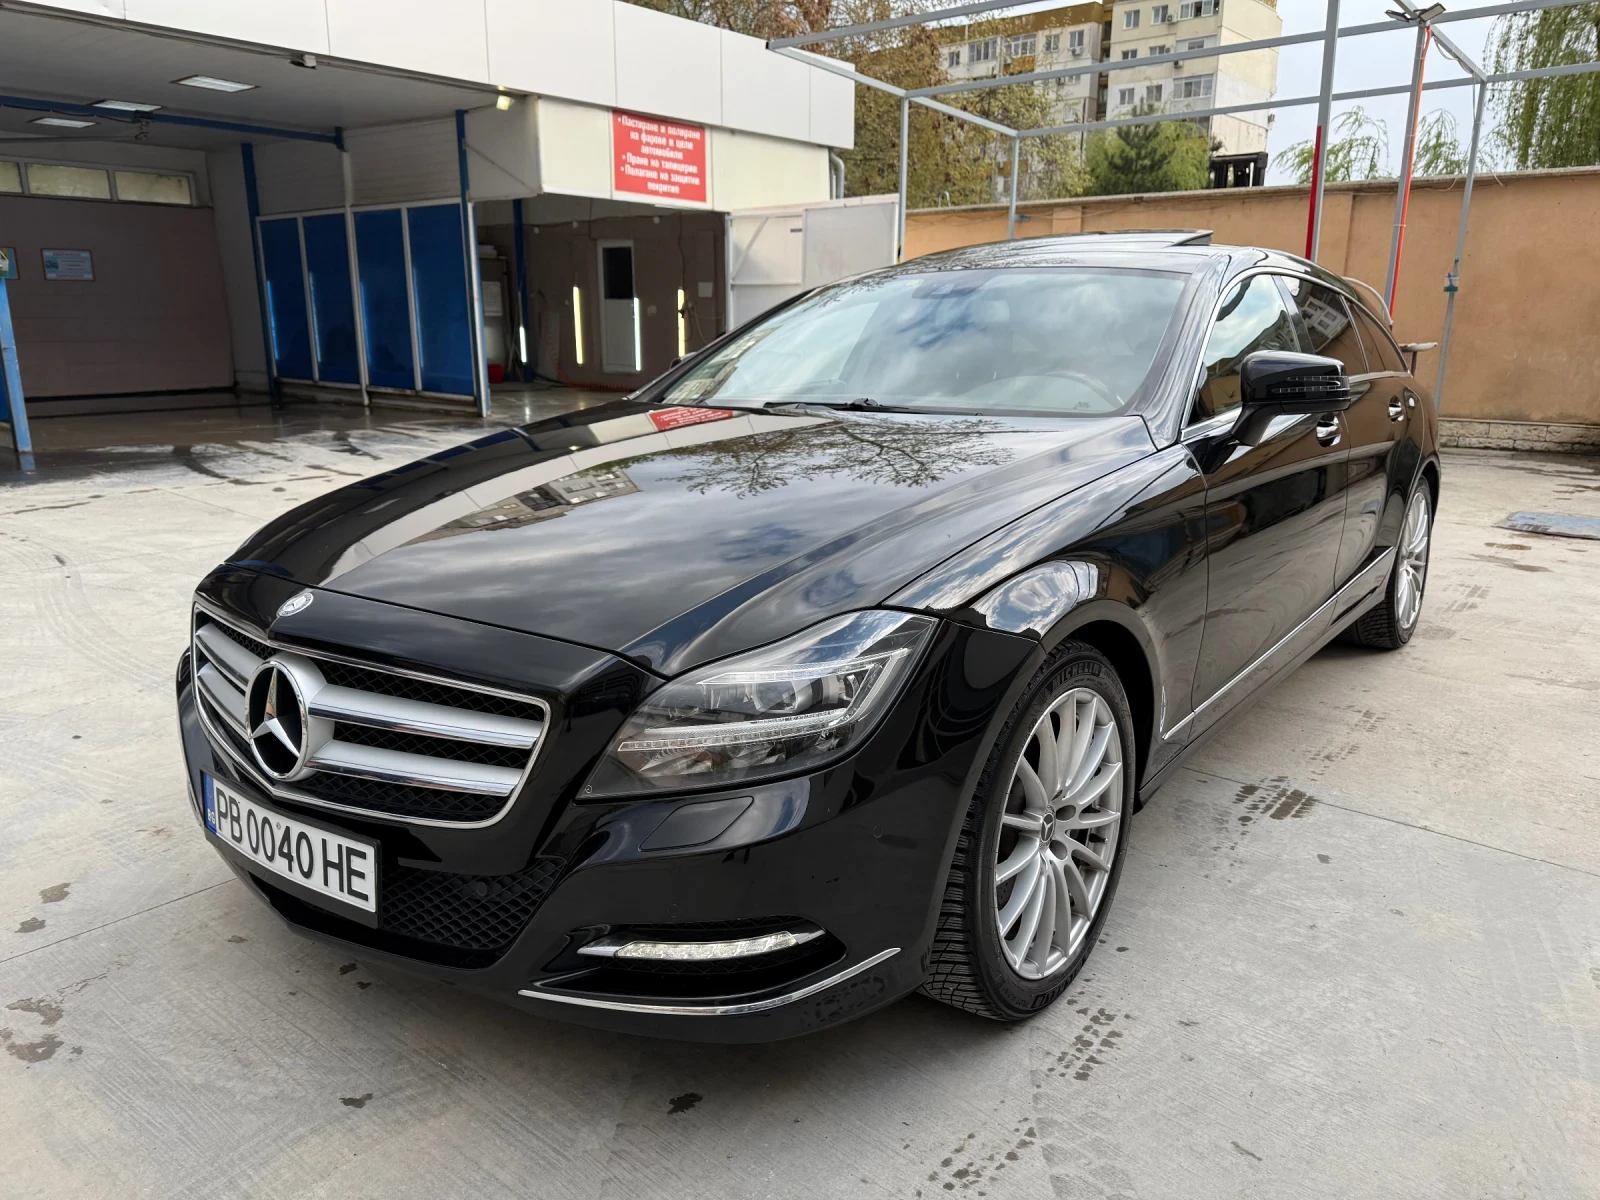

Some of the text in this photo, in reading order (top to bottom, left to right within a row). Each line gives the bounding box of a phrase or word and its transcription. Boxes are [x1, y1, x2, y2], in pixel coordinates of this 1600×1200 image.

[630, 131, 639, 140] на
[641, 131, 666, 146] фарове
[667, 126, 701, 140] полиране
[626, 152, 648, 166] Пране
[650, 159, 660, 168] на
[641, 145, 683, 160] автомобили
[625, 164, 700, 185] Полагане на защитни
[1052, 662, 1101, 691] MICHELIN
[207, 809, 216, 825] BG
[216, 786, 369, 902] PB 0040 HE
